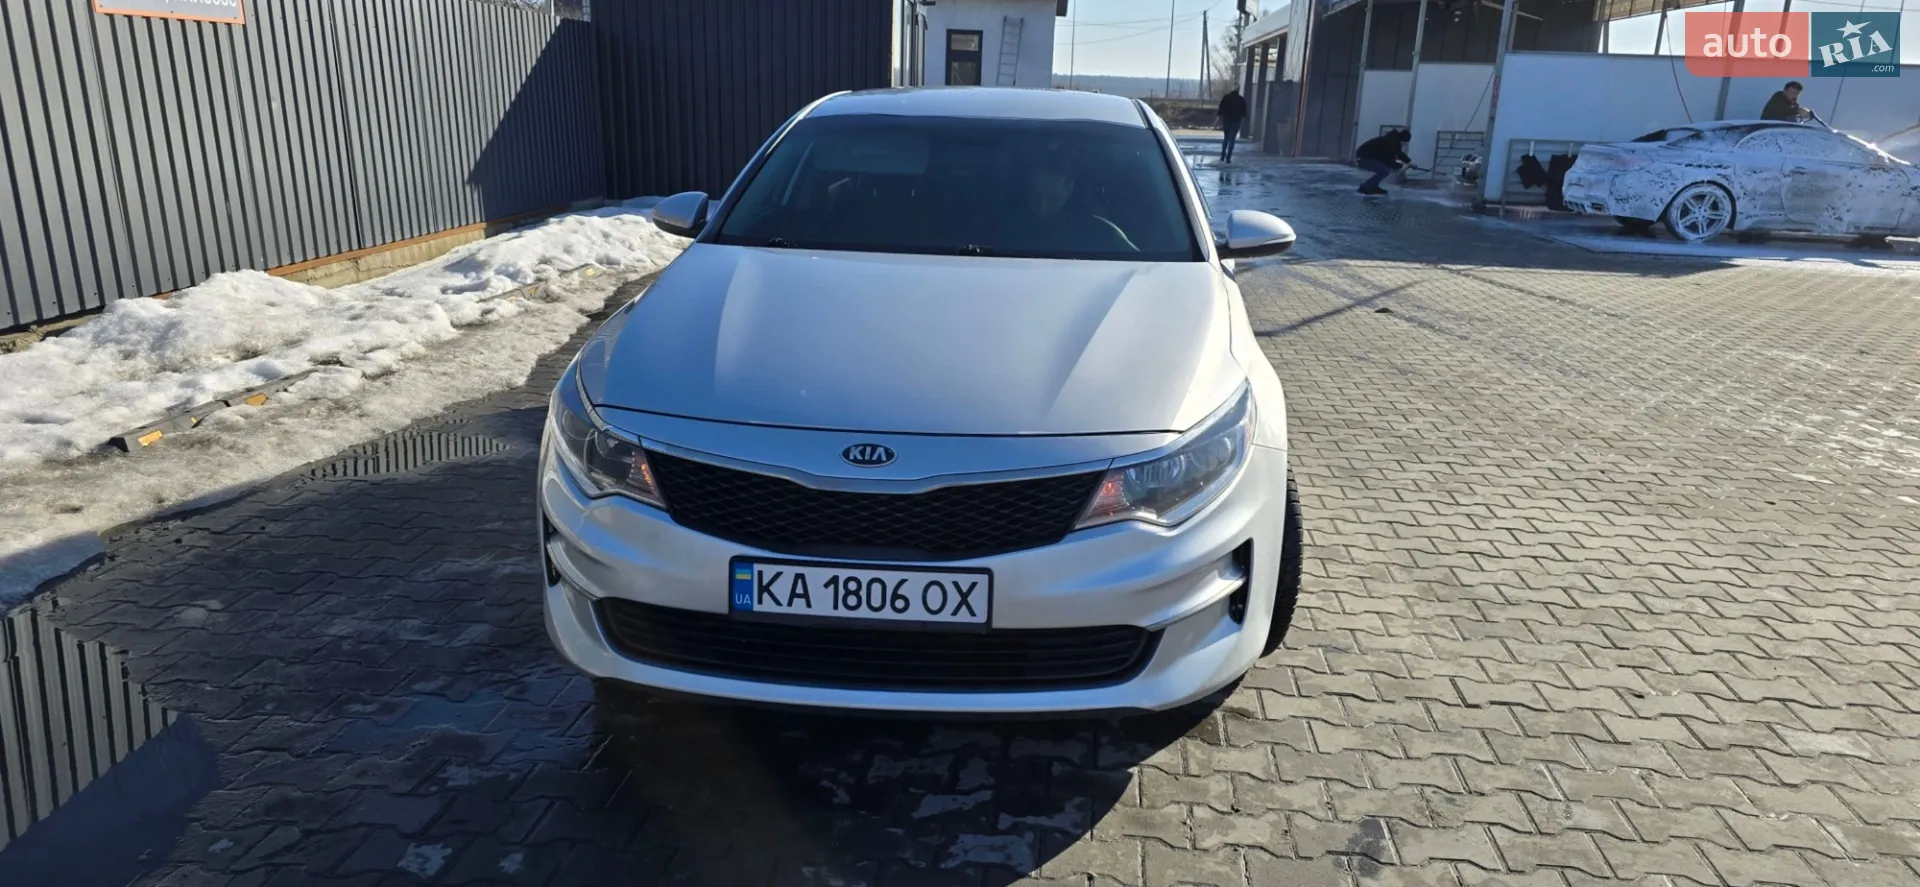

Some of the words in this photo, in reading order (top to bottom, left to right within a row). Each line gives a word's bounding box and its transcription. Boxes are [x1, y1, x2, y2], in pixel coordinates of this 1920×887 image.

[849, 446, 887, 461] KIA
[735, 593, 751, 605] UA
[756, 570, 812, 609] KA
[823, 575, 911, 614] 1806
[921, 580, 979, 617] OX
